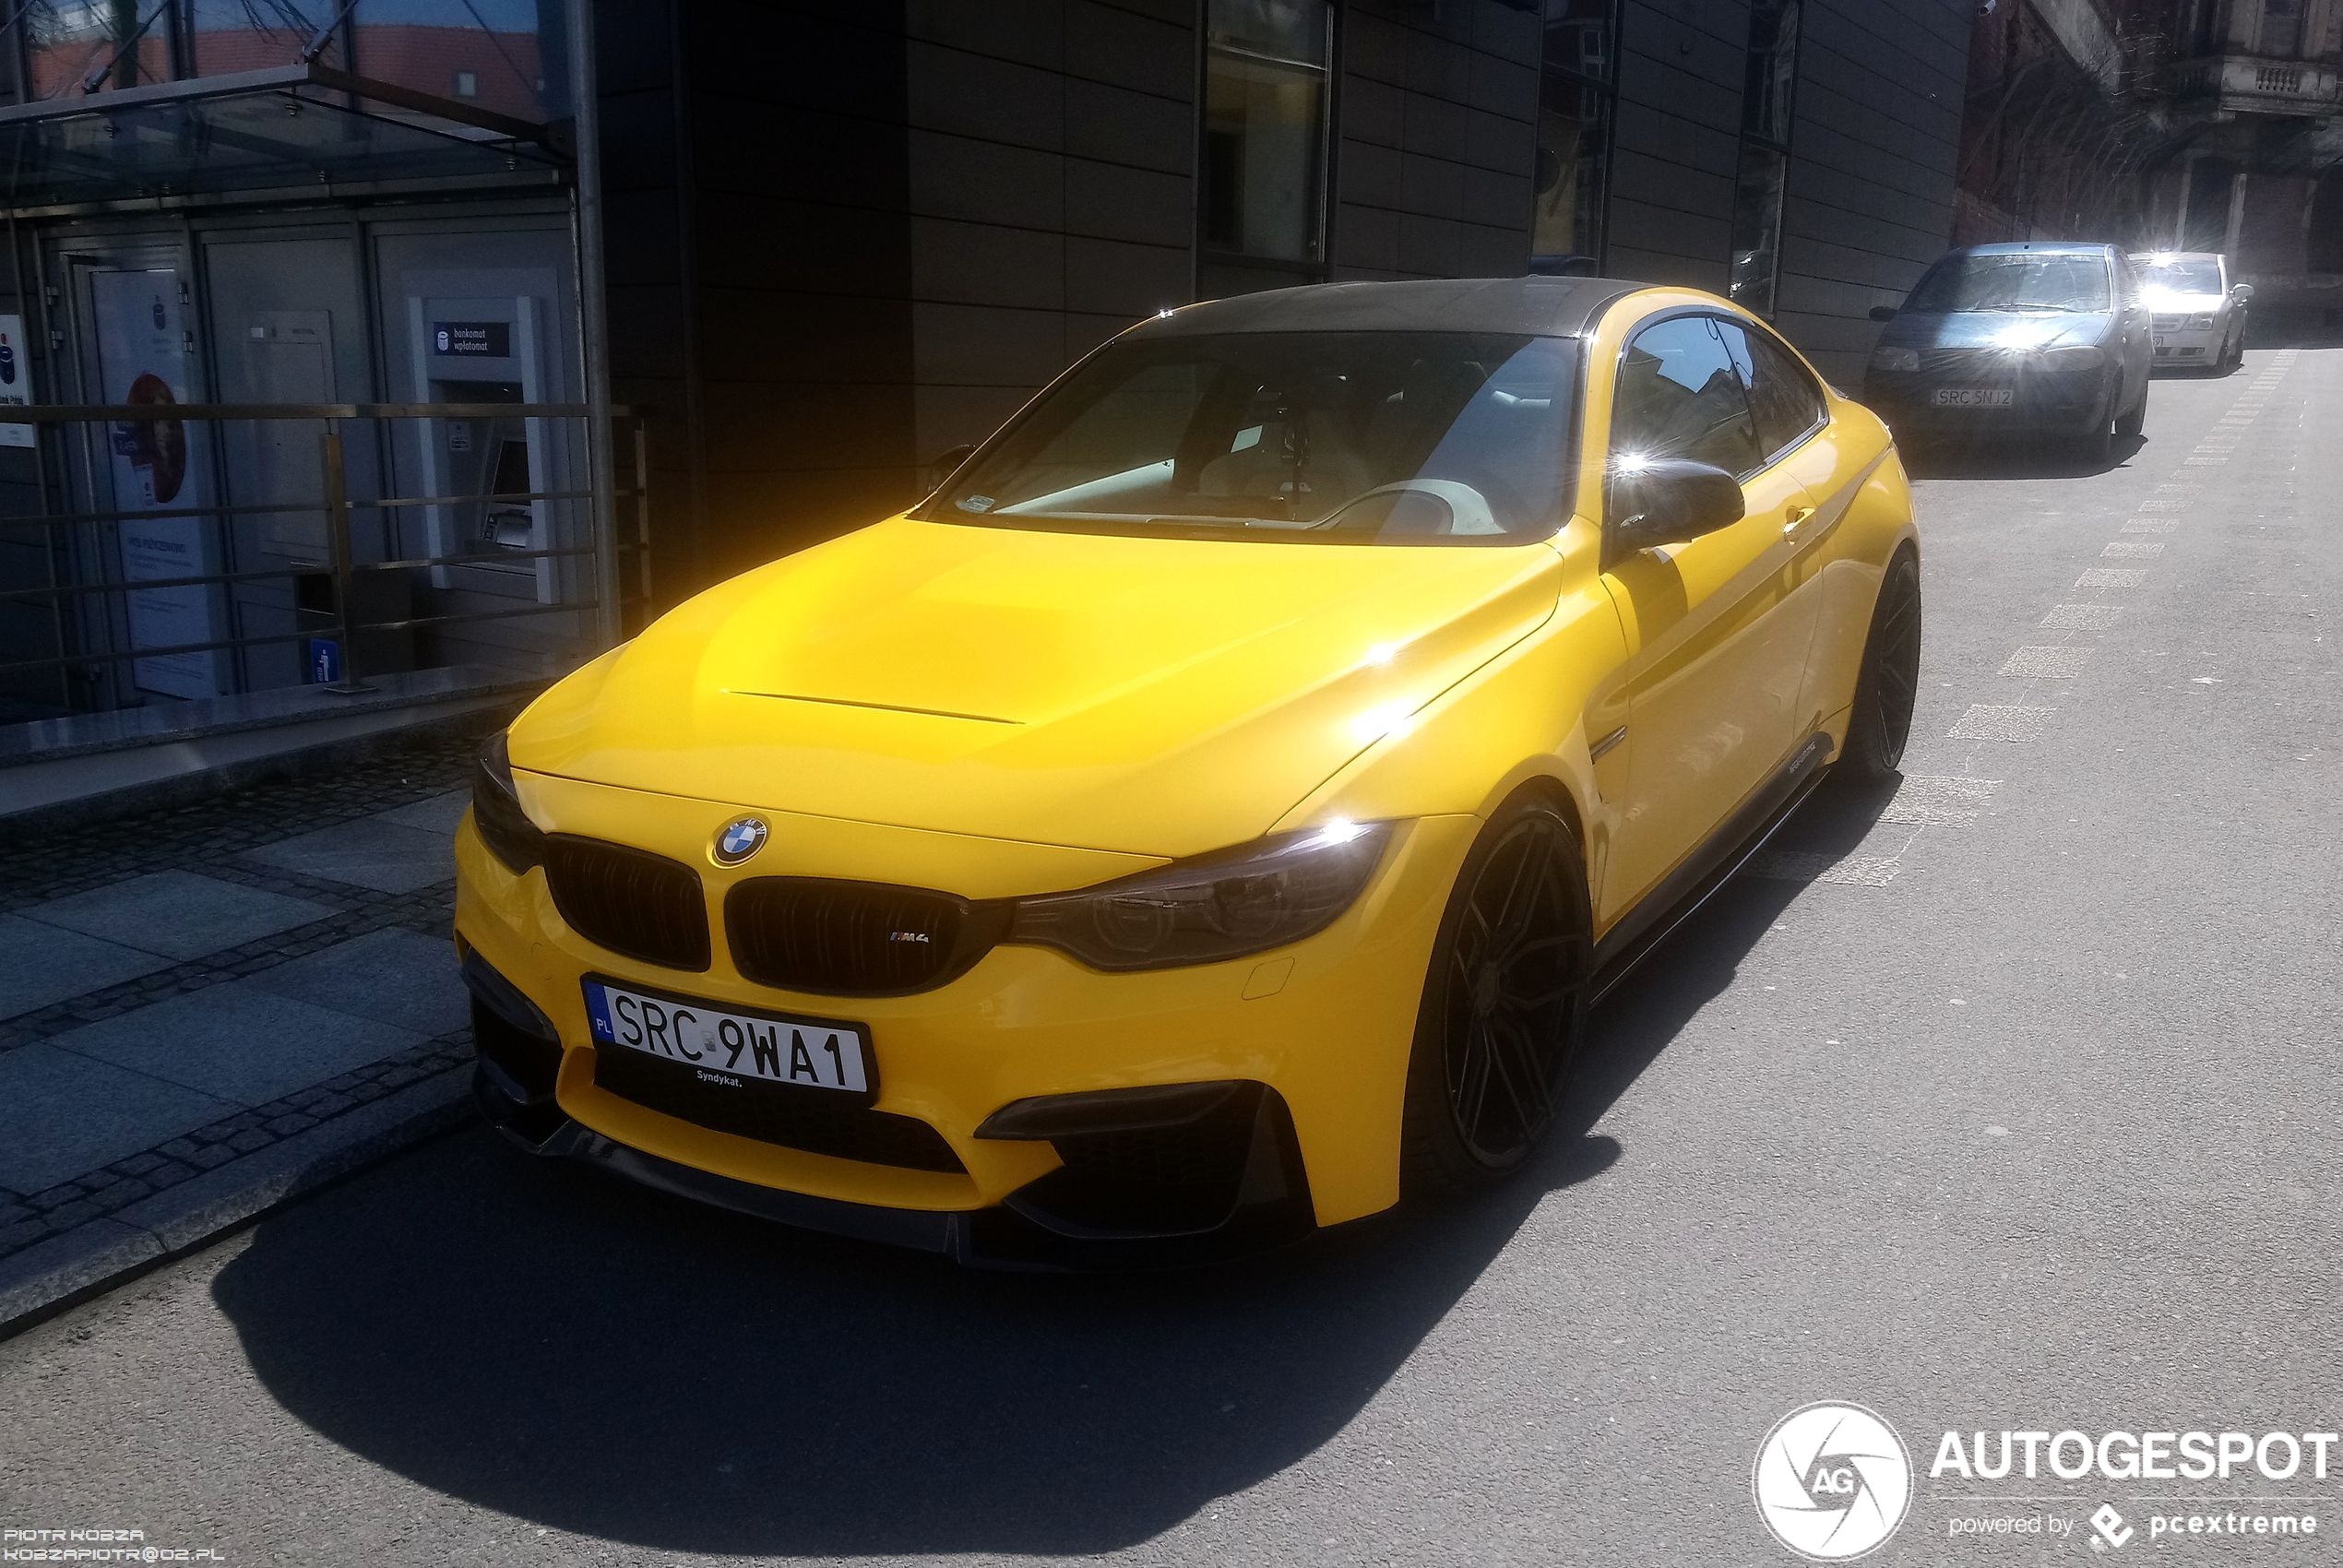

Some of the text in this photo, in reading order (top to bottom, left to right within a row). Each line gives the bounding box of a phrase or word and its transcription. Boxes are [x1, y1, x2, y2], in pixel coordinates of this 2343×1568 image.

[454, 328, 486, 339] bankomat
[1939, 390, 1970, 405] SRC
[596, 1018, 613, 1035] PL
[614, 995, 847, 1087] SRC 9WA1
[696, 1070, 743, 1087] Syndykat.
